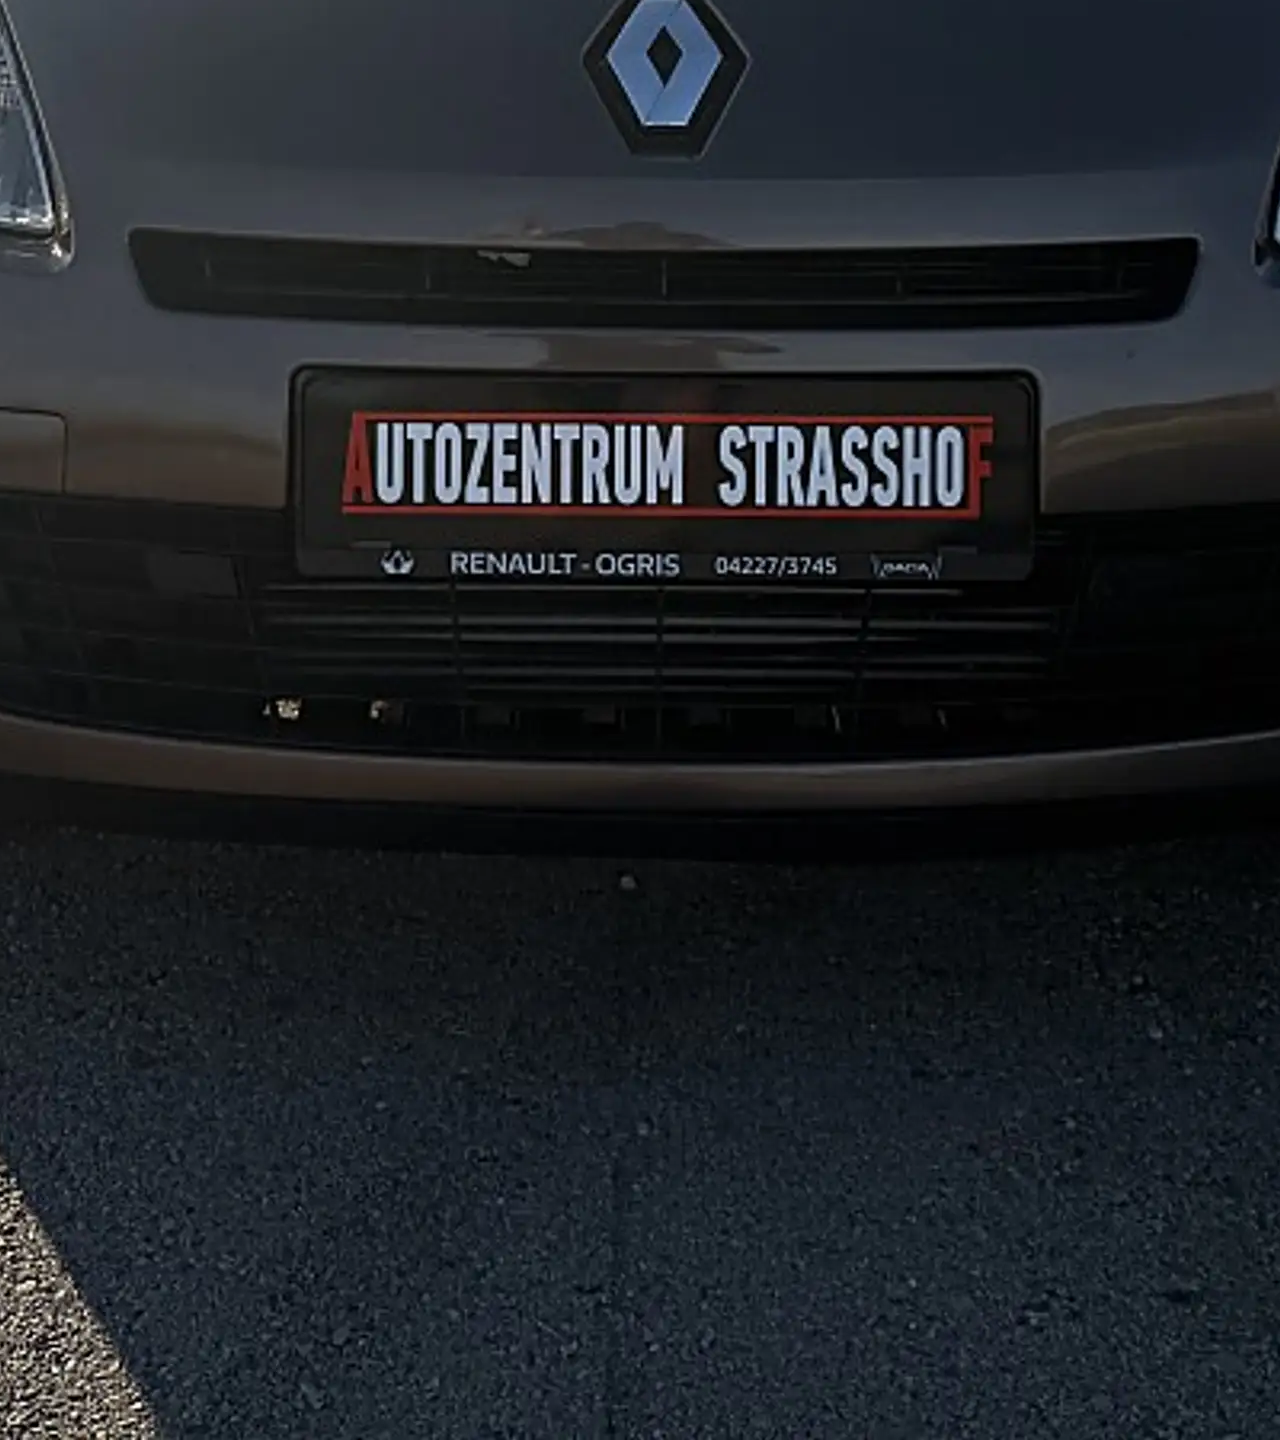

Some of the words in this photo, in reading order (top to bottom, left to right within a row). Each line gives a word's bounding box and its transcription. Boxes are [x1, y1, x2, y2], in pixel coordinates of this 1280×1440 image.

[342, 412, 684, 505] AUTOZENTRUM
[717, 424, 993, 517] STRASSHOF
[450, 552, 578, 574] RENAULT
[594, 553, 680, 577] OGRIS
[715, 556, 837, 577] 04227/3745
